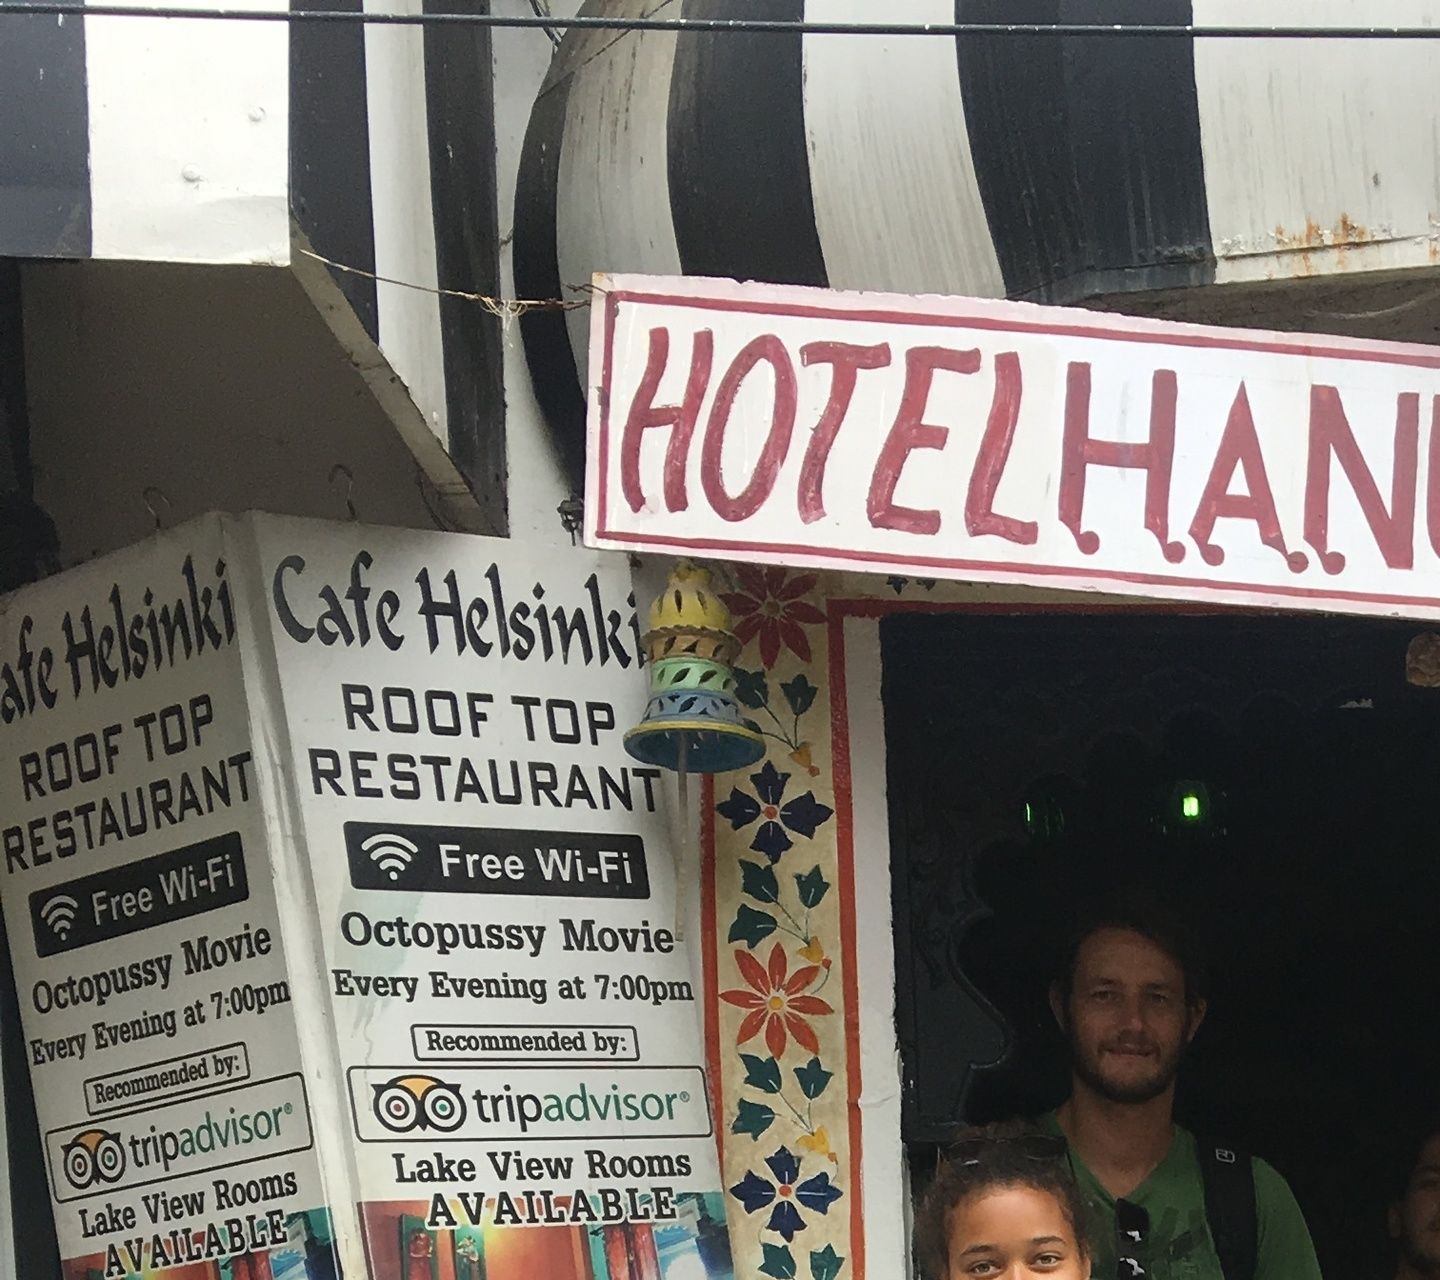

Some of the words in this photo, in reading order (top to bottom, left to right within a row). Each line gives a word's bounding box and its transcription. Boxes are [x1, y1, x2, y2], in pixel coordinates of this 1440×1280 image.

[620, 327, 1038, 546] HOTEL
[0, 615, 58, 725] afe
[62, 554, 235, 700] Helsinki
[272, 550, 405, 651] Cafe
[414, 562, 648, 669] Helsinki
[20, 722, 122, 802] ROOF
[134, 694, 214, 765] TOP
[341, 683, 493, 738] ROOF
[511, 695, 616, 746] TOP
[3, 751, 252, 874] RESTAURANT
[308, 748, 661, 813] RESTAURANT
[91, 883, 154, 927] Free
[158, 853, 236, 904] Wi-Fi
[440, 845, 524, 882] Free
[535, 848, 634, 886] Wi-Fi
[32, 953, 172, 1015] Octopussy
[181, 923, 272, 977] Movie
[340, 912, 546, 957] Octopussy
[561, 918, 676, 953] Movie
[31, 1031, 87, 1066] Every
[92, 1013, 177, 1054] Evening
[183, 1000, 206, 1028] at
[210, 977, 292, 1023] 7:00pm
[332, 970, 418, 1002] Every
[429, 972, 547, 1004] Evening
[558, 978, 587, 1001] at
[594, 975, 694, 1004] 7:00pm
[426, 1029, 587, 1054] Recommended
[592, 1031, 627, 1055] by:
[94, 1062, 209, 1104] Recommended
[214, 1054, 241, 1080] by:
[392, 1152, 477, 1183] Lake
[487, 1152, 574, 1181] View
[587, 1150, 692, 1178] Rooms
[79, 1194, 136, 1239] Lake
[142, 1183, 205, 1224] View
[214, 1169, 297, 1206] Rooms
[426, 1186, 679, 1230] AVAILABLE
[103, 1210, 289, 1280] AVAILABLE
